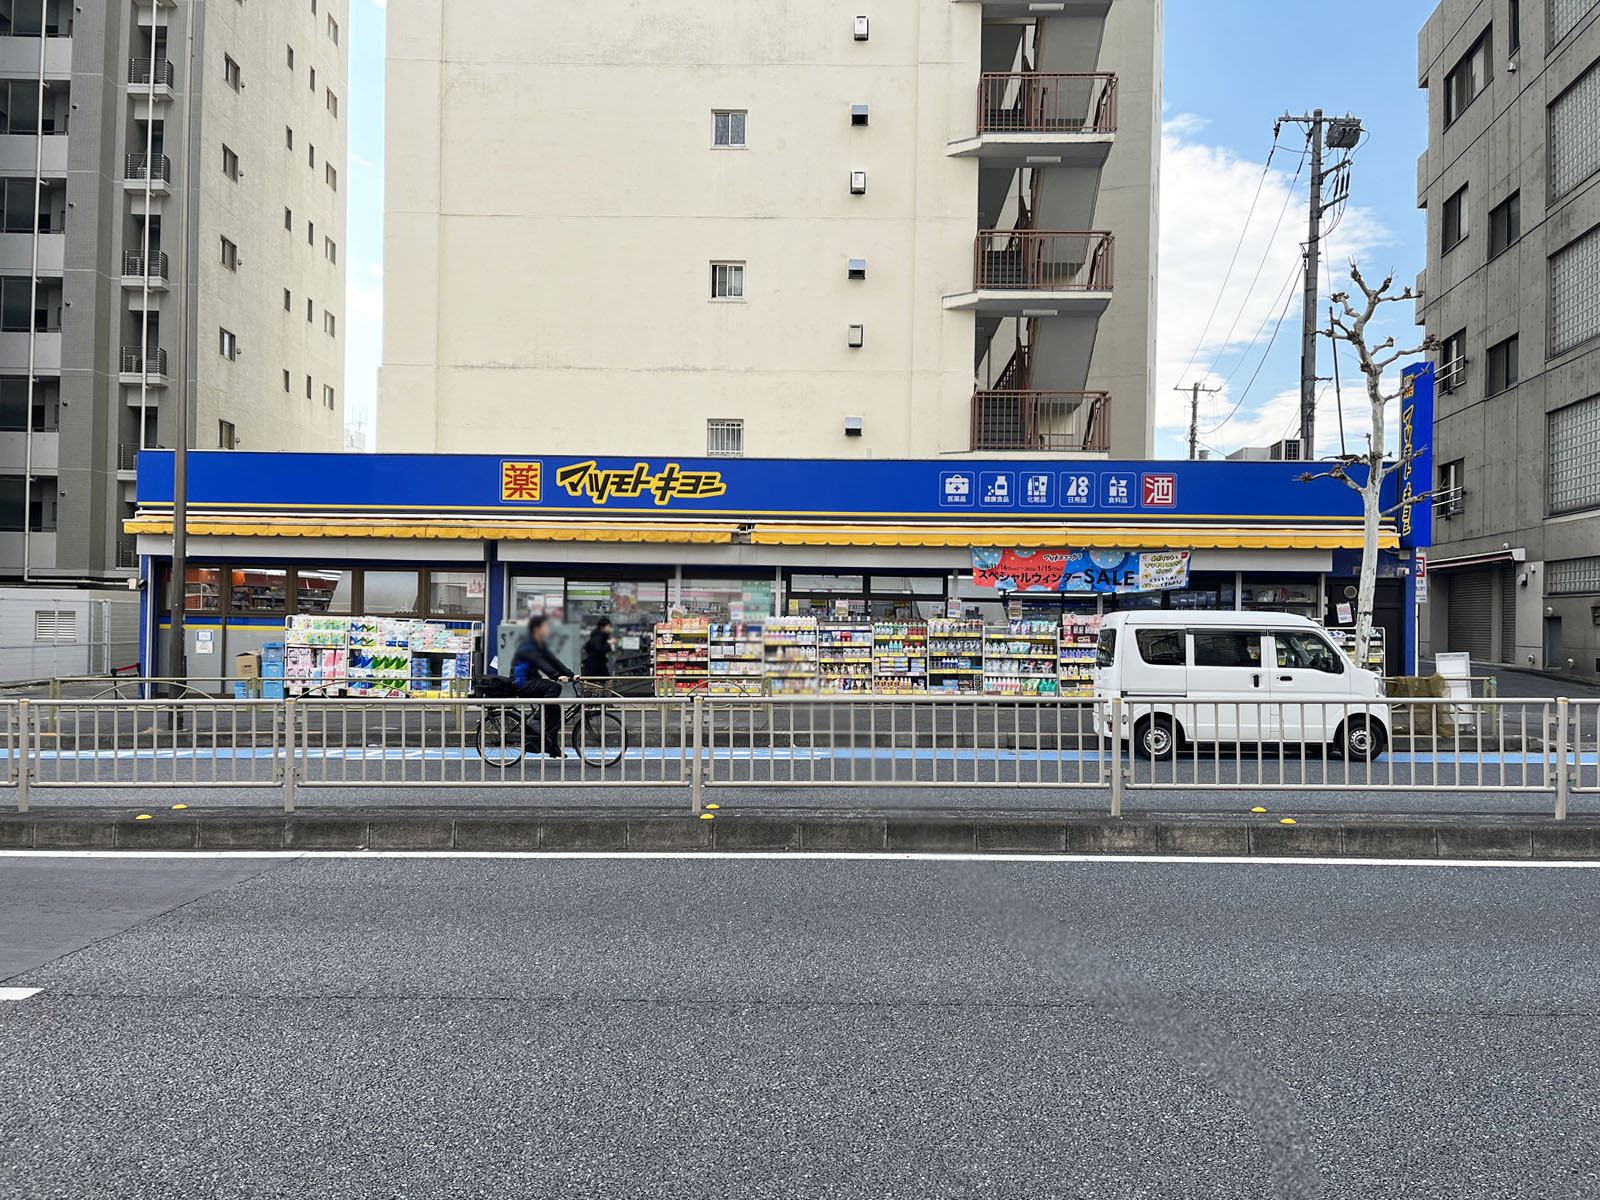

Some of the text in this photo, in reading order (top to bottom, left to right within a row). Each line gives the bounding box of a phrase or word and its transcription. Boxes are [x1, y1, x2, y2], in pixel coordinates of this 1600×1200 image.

[503, 464, 539, 498] 薬
[557, 461, 726, 505] マツモトキヨシ
[1145, 477, 1173, 503] 酒
[1084, 568, 1135, 586] SALE
